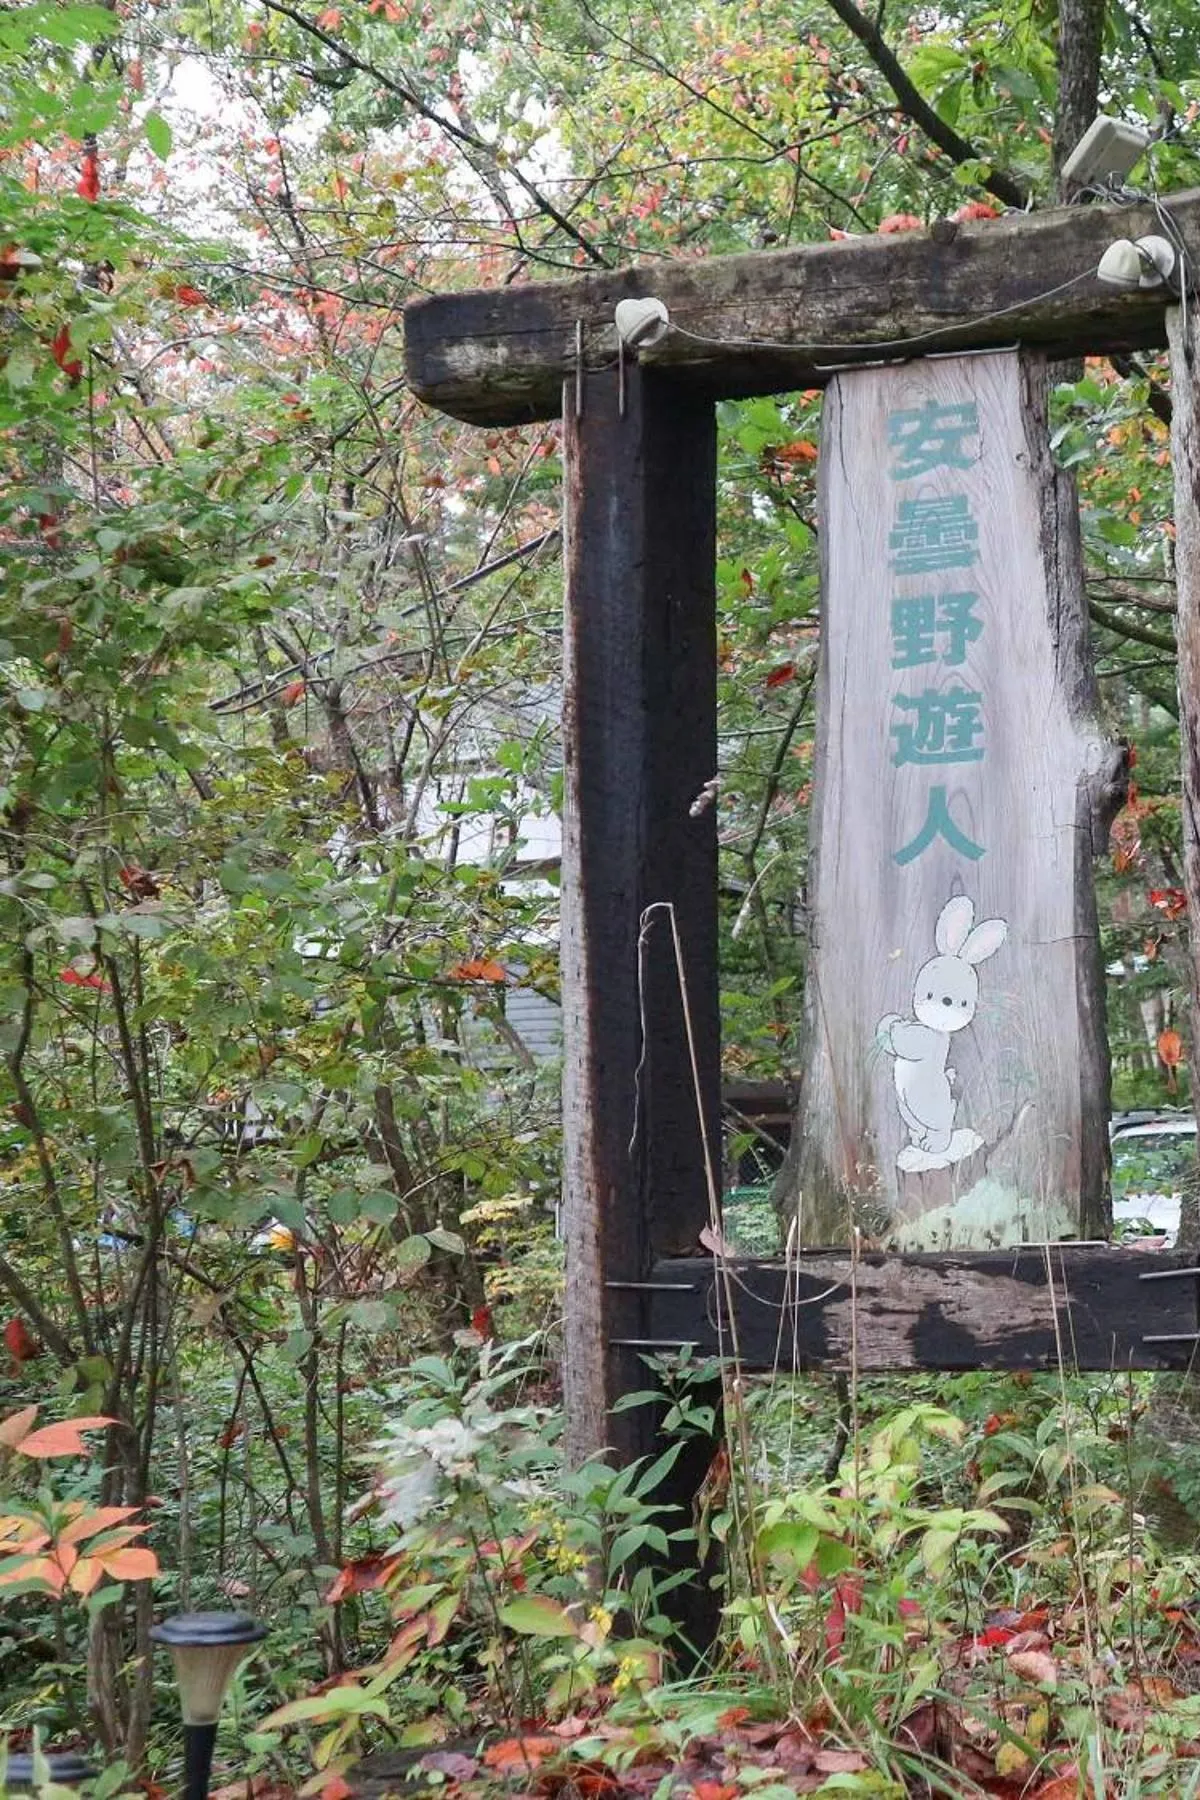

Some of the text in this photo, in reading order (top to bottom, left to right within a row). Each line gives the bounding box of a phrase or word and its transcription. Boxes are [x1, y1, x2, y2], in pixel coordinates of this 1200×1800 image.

[888, 400, 986, 866] 安曇野遊人
